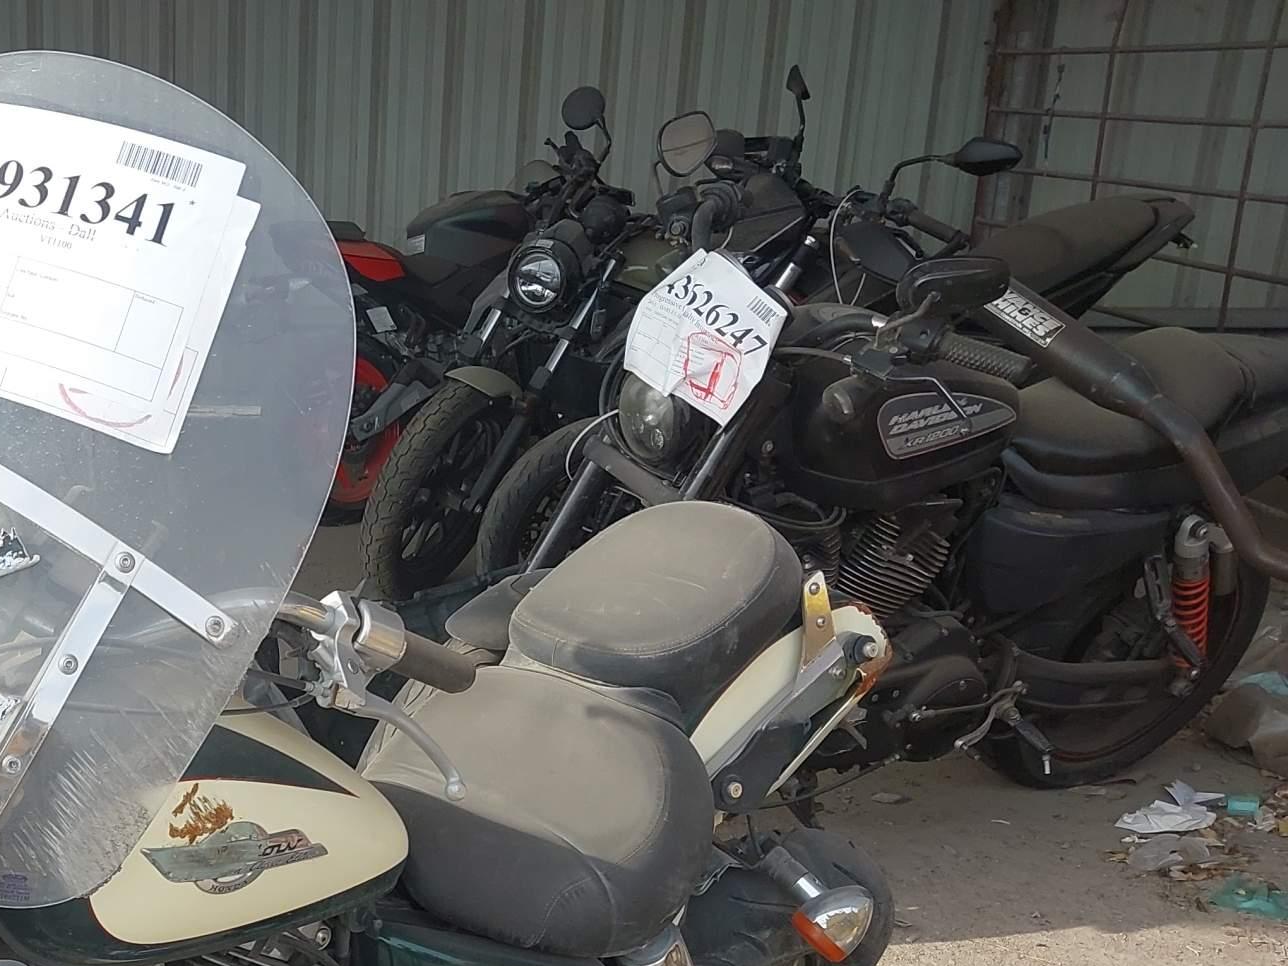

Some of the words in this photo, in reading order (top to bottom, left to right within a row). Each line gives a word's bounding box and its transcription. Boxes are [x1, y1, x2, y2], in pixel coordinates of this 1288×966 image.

[0, 207, 56, 232] Auctions
[40, 234, 73, 250] VT1100
[991, 297, 1050, 337] HINES
